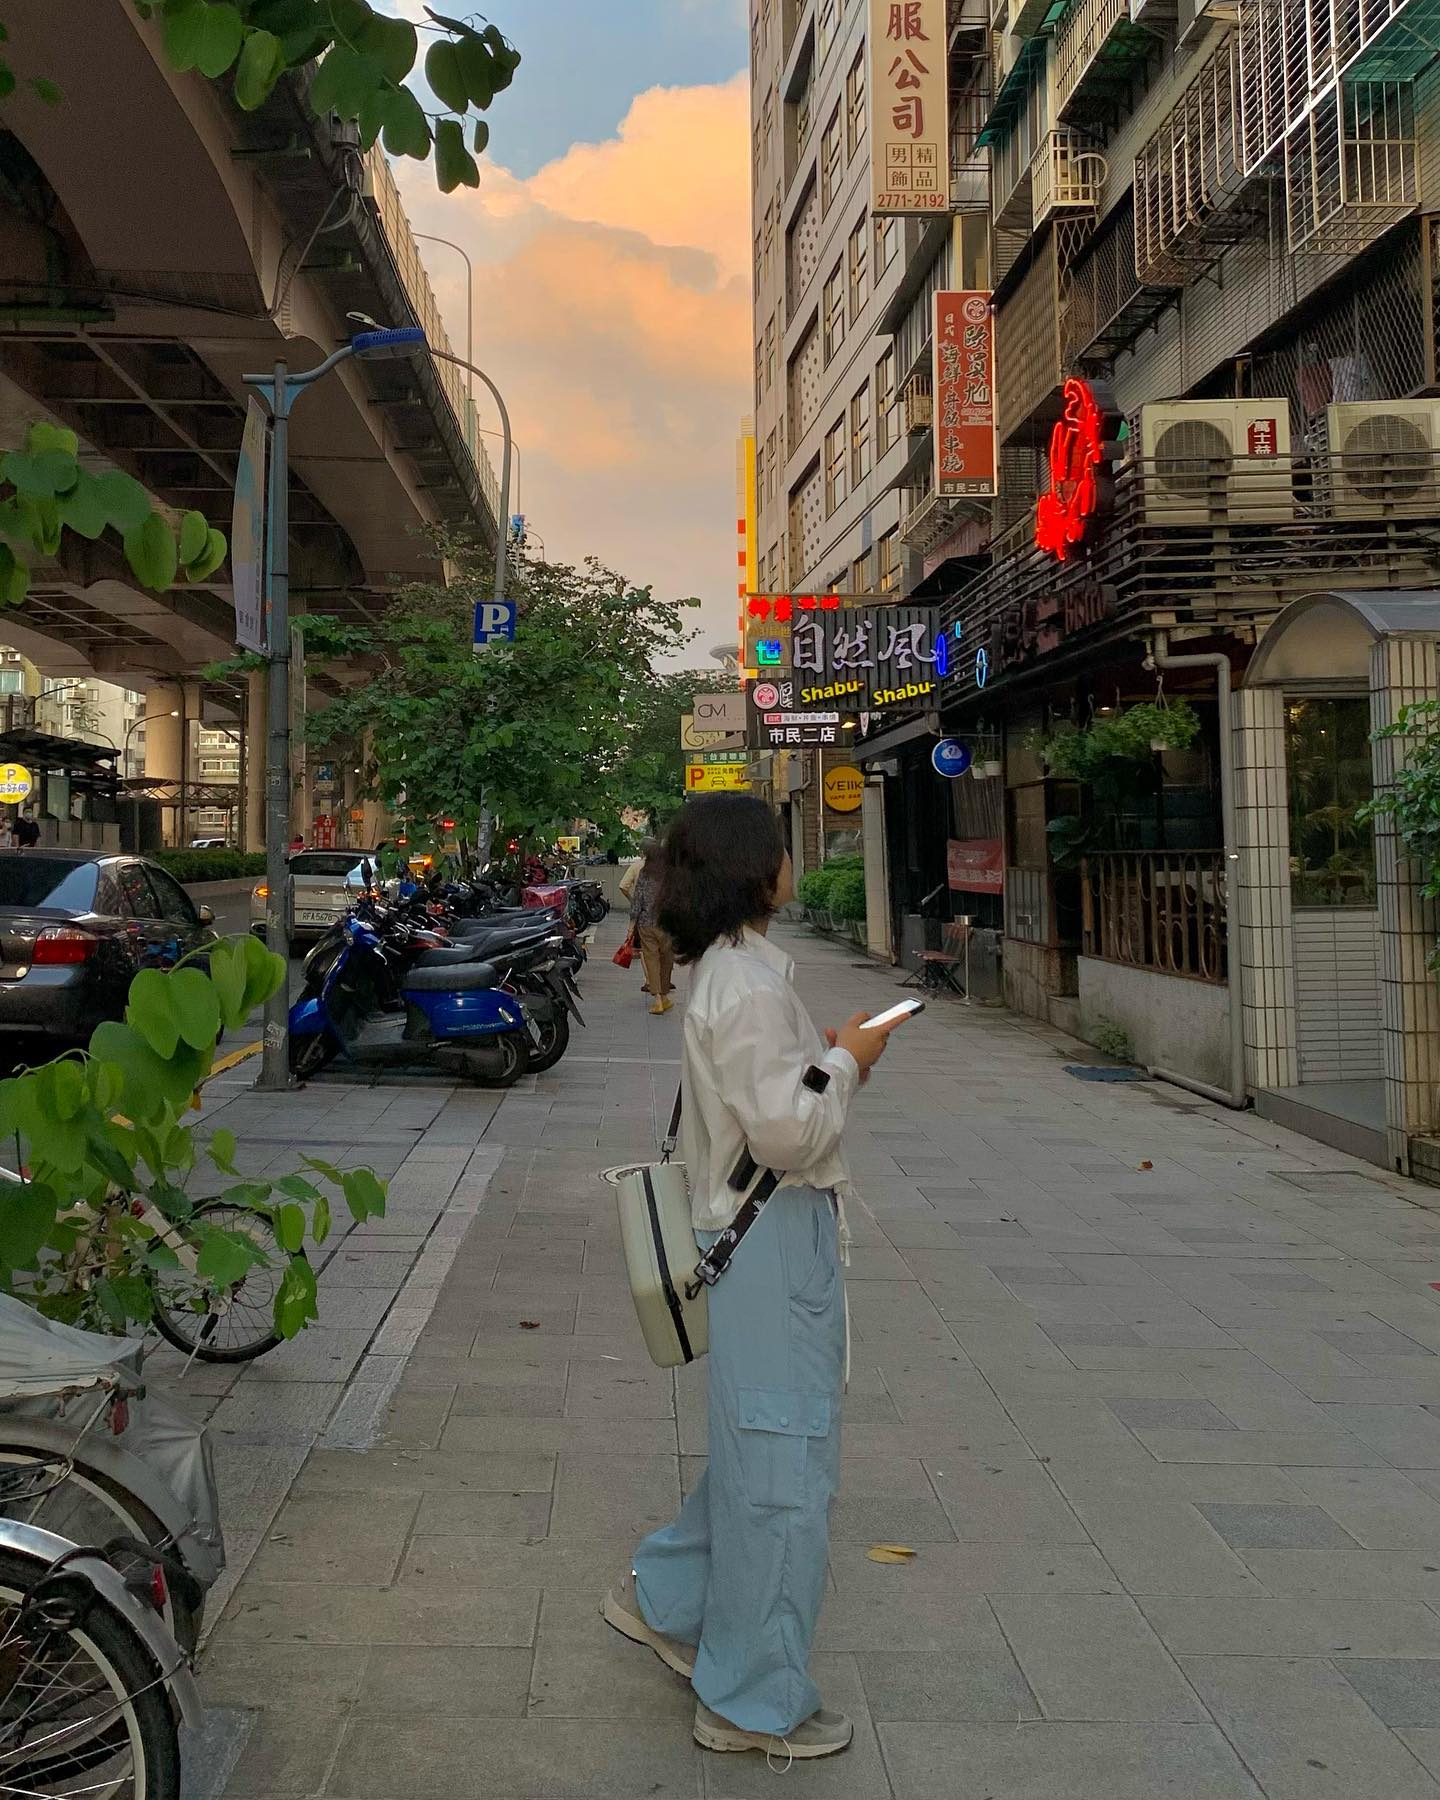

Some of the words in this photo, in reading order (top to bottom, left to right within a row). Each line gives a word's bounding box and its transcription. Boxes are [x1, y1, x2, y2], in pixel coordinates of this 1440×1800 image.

[886, 2, 930, 139] 服公司
[878, 194, 945, 208] 2771-2192
[944, 483, 990, 493] 市民二店
[480, 604, 510, 632] P
[793, 614, 939, 674] 自然風
[801, 680, 864, 703] Shabu-
[873, 682, 936, 706] Shabu-
[768, 726, 836, 744] 市民二店
[8, 768, 16, 781] P
[690, 767, 704, 787] P
